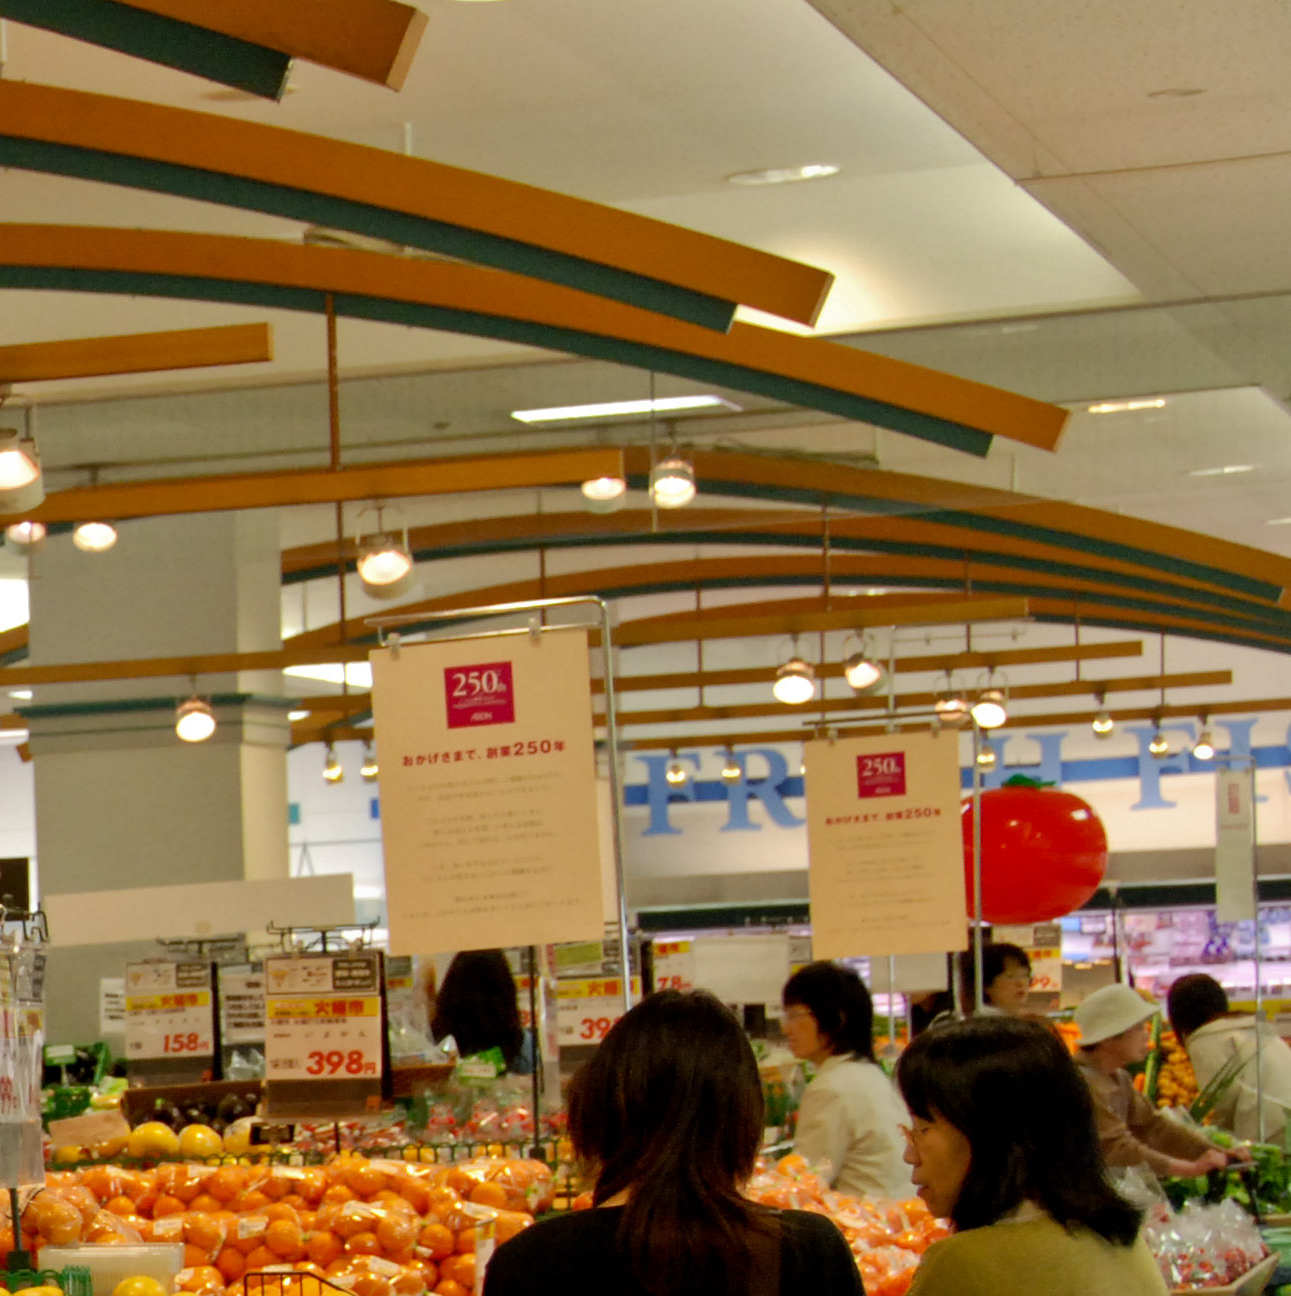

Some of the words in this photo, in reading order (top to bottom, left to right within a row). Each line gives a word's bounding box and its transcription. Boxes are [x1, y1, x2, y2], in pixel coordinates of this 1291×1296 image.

[635, 732, 1069, 837] FRH
[1122, 718, 1291, 811] FI
[305, 1050, 377, 1075] 398円
